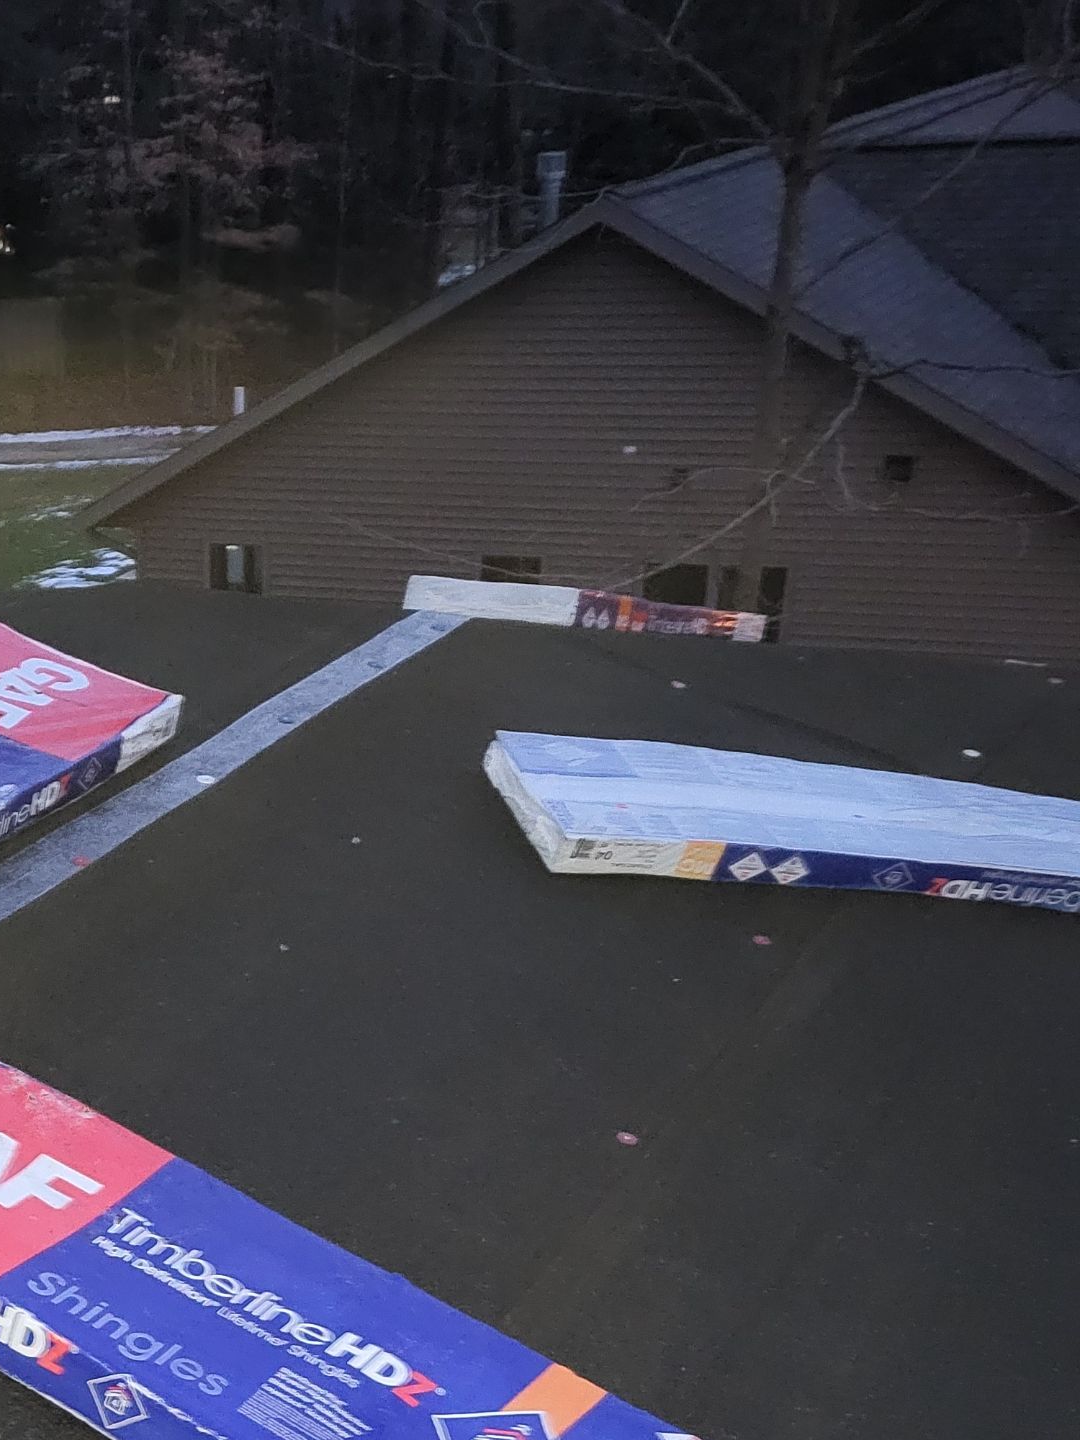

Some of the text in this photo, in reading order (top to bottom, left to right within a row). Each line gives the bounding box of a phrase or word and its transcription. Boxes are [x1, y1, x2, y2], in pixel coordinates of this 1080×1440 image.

[27, 1270, 232, 1397] Shingles
[91, 1235, 361, 1390] High Definition Lifetime Shingles
